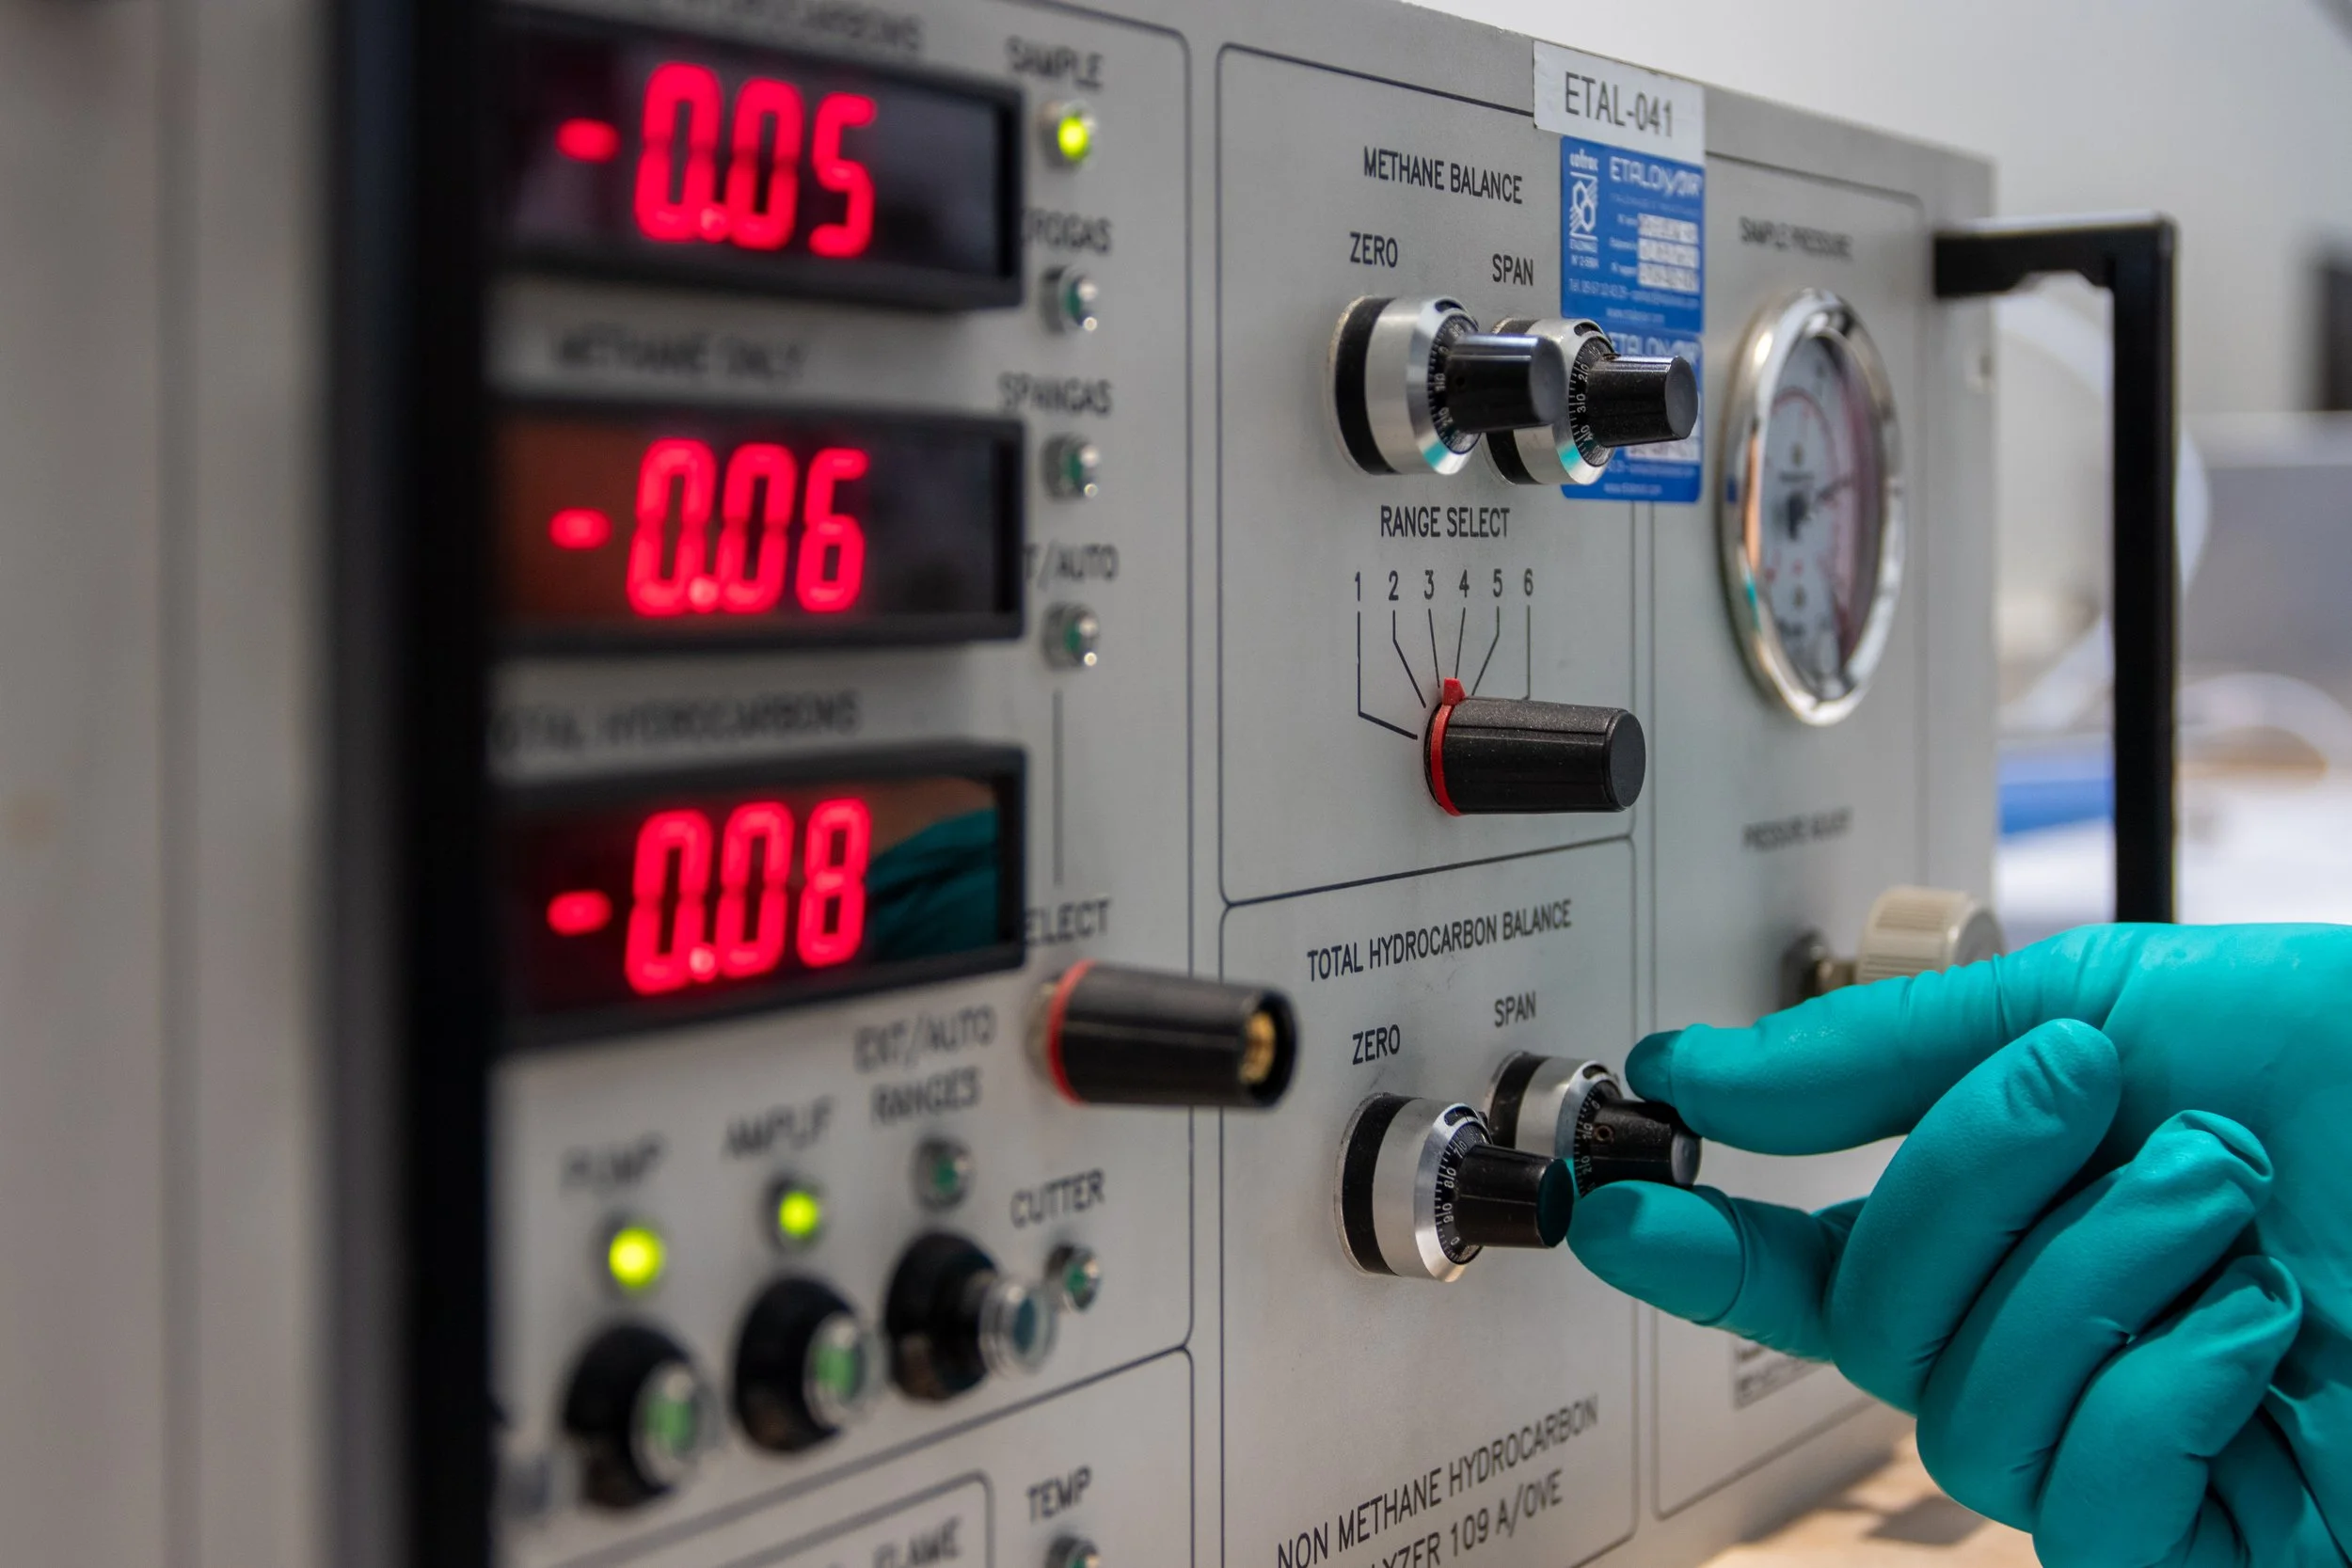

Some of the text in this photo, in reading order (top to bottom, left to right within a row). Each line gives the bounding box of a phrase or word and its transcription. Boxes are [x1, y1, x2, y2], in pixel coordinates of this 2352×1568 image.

[1003, 35, 1104, 93] SAMPLE
[1565, 71, 1675, 138] ETAL-041
[556, 62, 877, 258] -0.05
[1363, 145, 1523, 205] METHANE BALANCE
[1349, 231, 1399, 268] ZERO
[1492, 253, 1534, 287] SPAN
[549, 438, 869, 616] -0.06
[1380, 505, 1511, 538] RANGE SELECT
[1354, 568, 1534, 602] 1 2 3 4 5 6
[548, 799, 871, 996] -0.08
[1024, 897, 1112, 946] ELECT
[1307, 898, 1573, 983] TOTAL HYDROCARBON BALANCE
[1494, 990, 1537, 1028] SPAN
[1351, 1023, 1402, 1066] ZERO
[1010, 1167, 1105, 1229] CUTTER
[1025, 1465, 1092, 1524] TEMP
[1278, 1393, 1598, 1568] NON METHANE HYDROCARBON
[1450, 1513, 1489, 1559] 109
